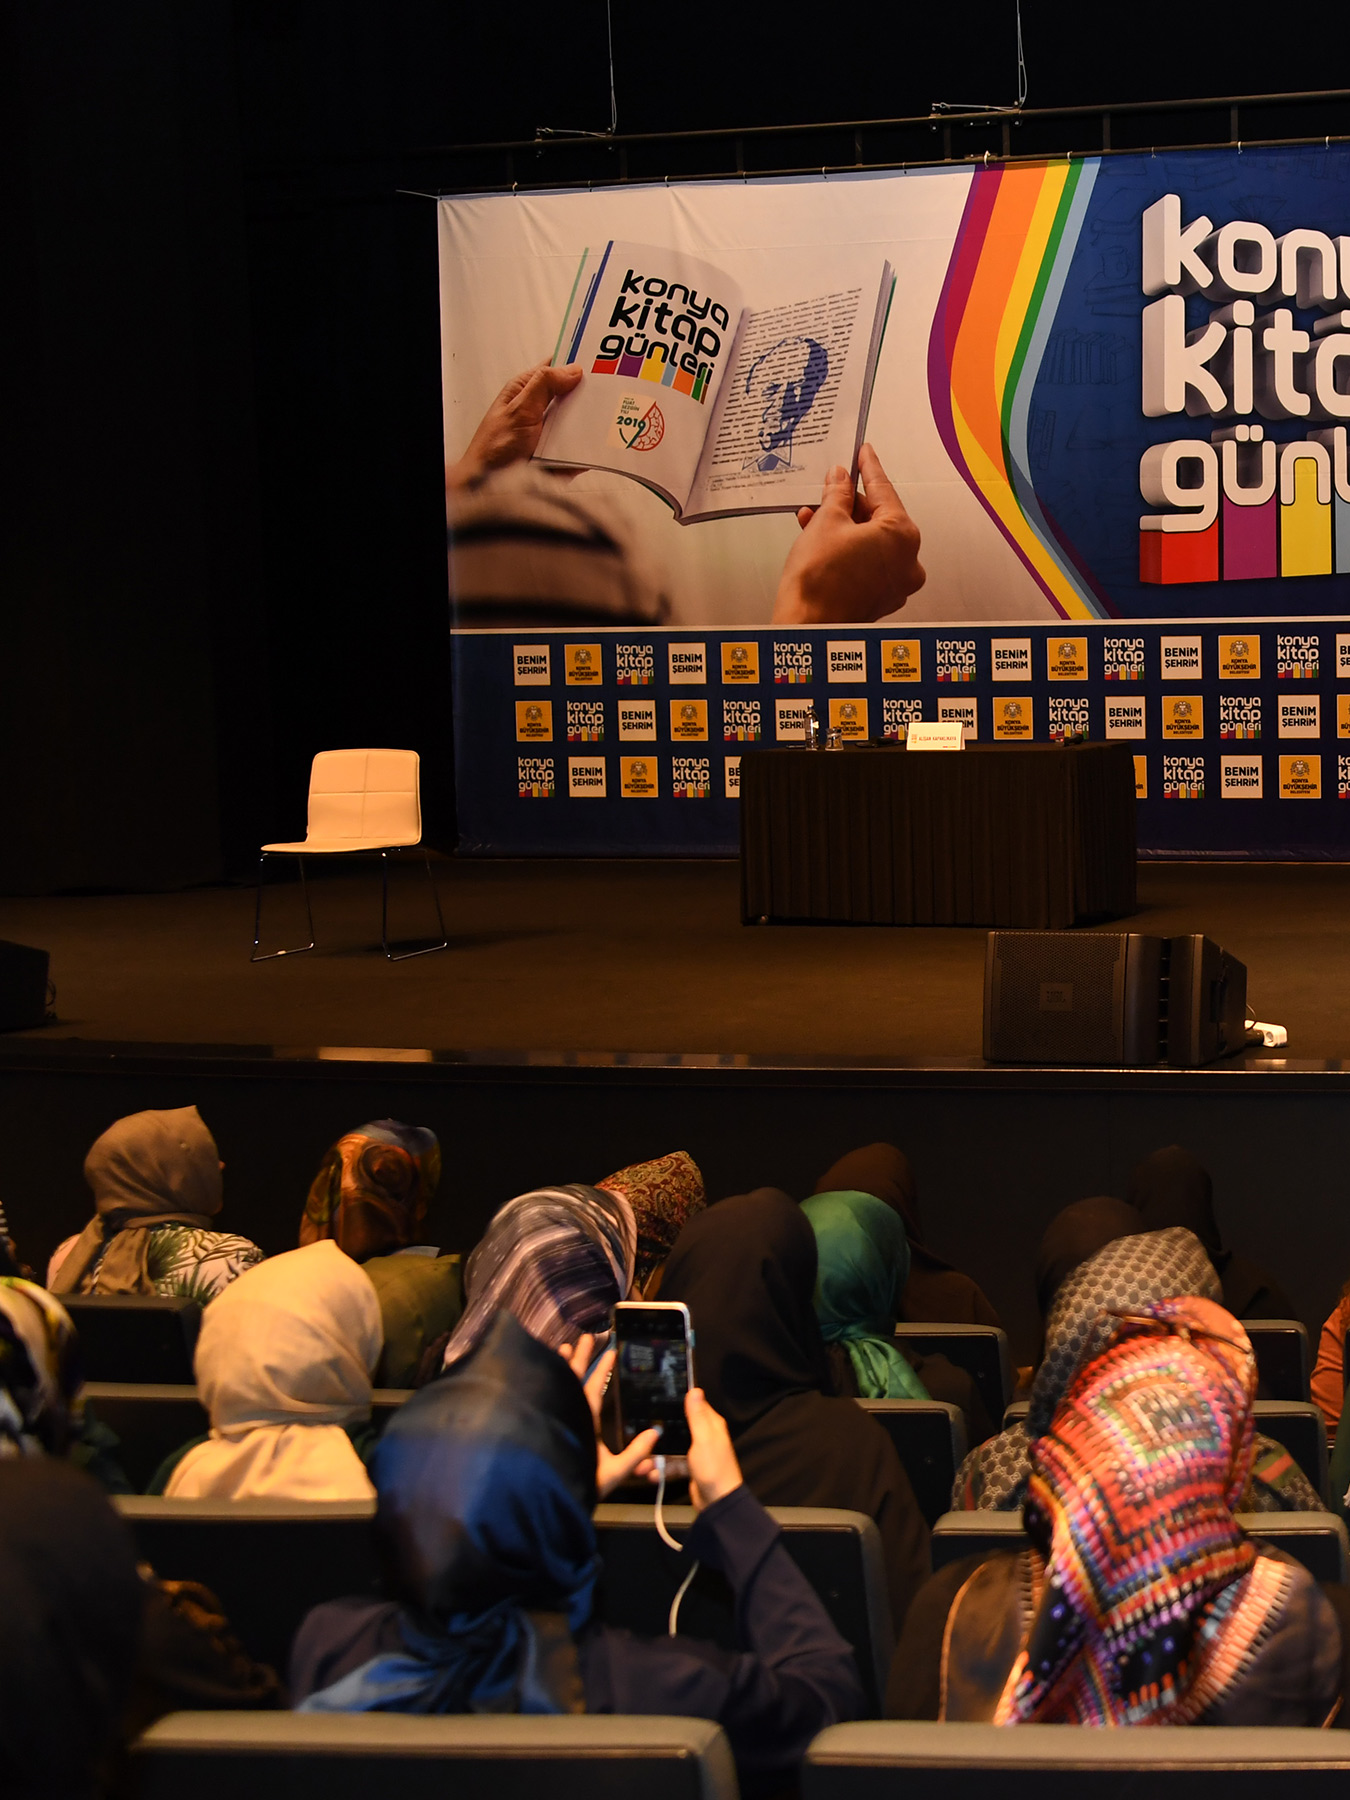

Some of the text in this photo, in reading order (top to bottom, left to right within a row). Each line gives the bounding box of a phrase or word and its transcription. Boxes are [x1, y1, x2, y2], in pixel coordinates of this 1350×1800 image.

[620, 269, 731, 331] konya
[608, 296, 721, 358] kitap
[596, 332, 715, 385] günleri
[616, 416, 646, 449] 2019
[775, 642, 812, 654] konya
[937, 640, 976, 653] konya
[1105, 637, 1144, 650] konya
[1278, 635, 1319, 648] konya
[617, 644, 653, 656] konya
[1105, 648, 1143, 663] kitap
[1278, 646, 1318, 661] kitap
[617, 654, 653, 669] kitap
[775, 653, 811, 667] kitap
[937, 651, 975, 666] kitap
[568, 700, 604, 713] konya
[724, 700, 761, 712] konya
[882, 698, 922, 712] konya
[1050, 696, 1089, 710] konya
[1221, 696, 1261, 709] konya
[568, 711, 603, 725] kitap
[724, 710, 760, 725] kitap
[883, 709, 922, 723] kitap
[1050, 708, 1088, 723] kitap
[1221, 707, 1260, 722] kitap
[780, 721, 804, 730] ŞEHRİ
[519, 756, 554, 769] konya
[673, 756, 710, 769] konya
[1165, 756, 1204, 769] konya
[519, 767, 554, 782] kitap
[673, 768, 709, 782] kitap
[1165, 767, 1203, 782] kitap
